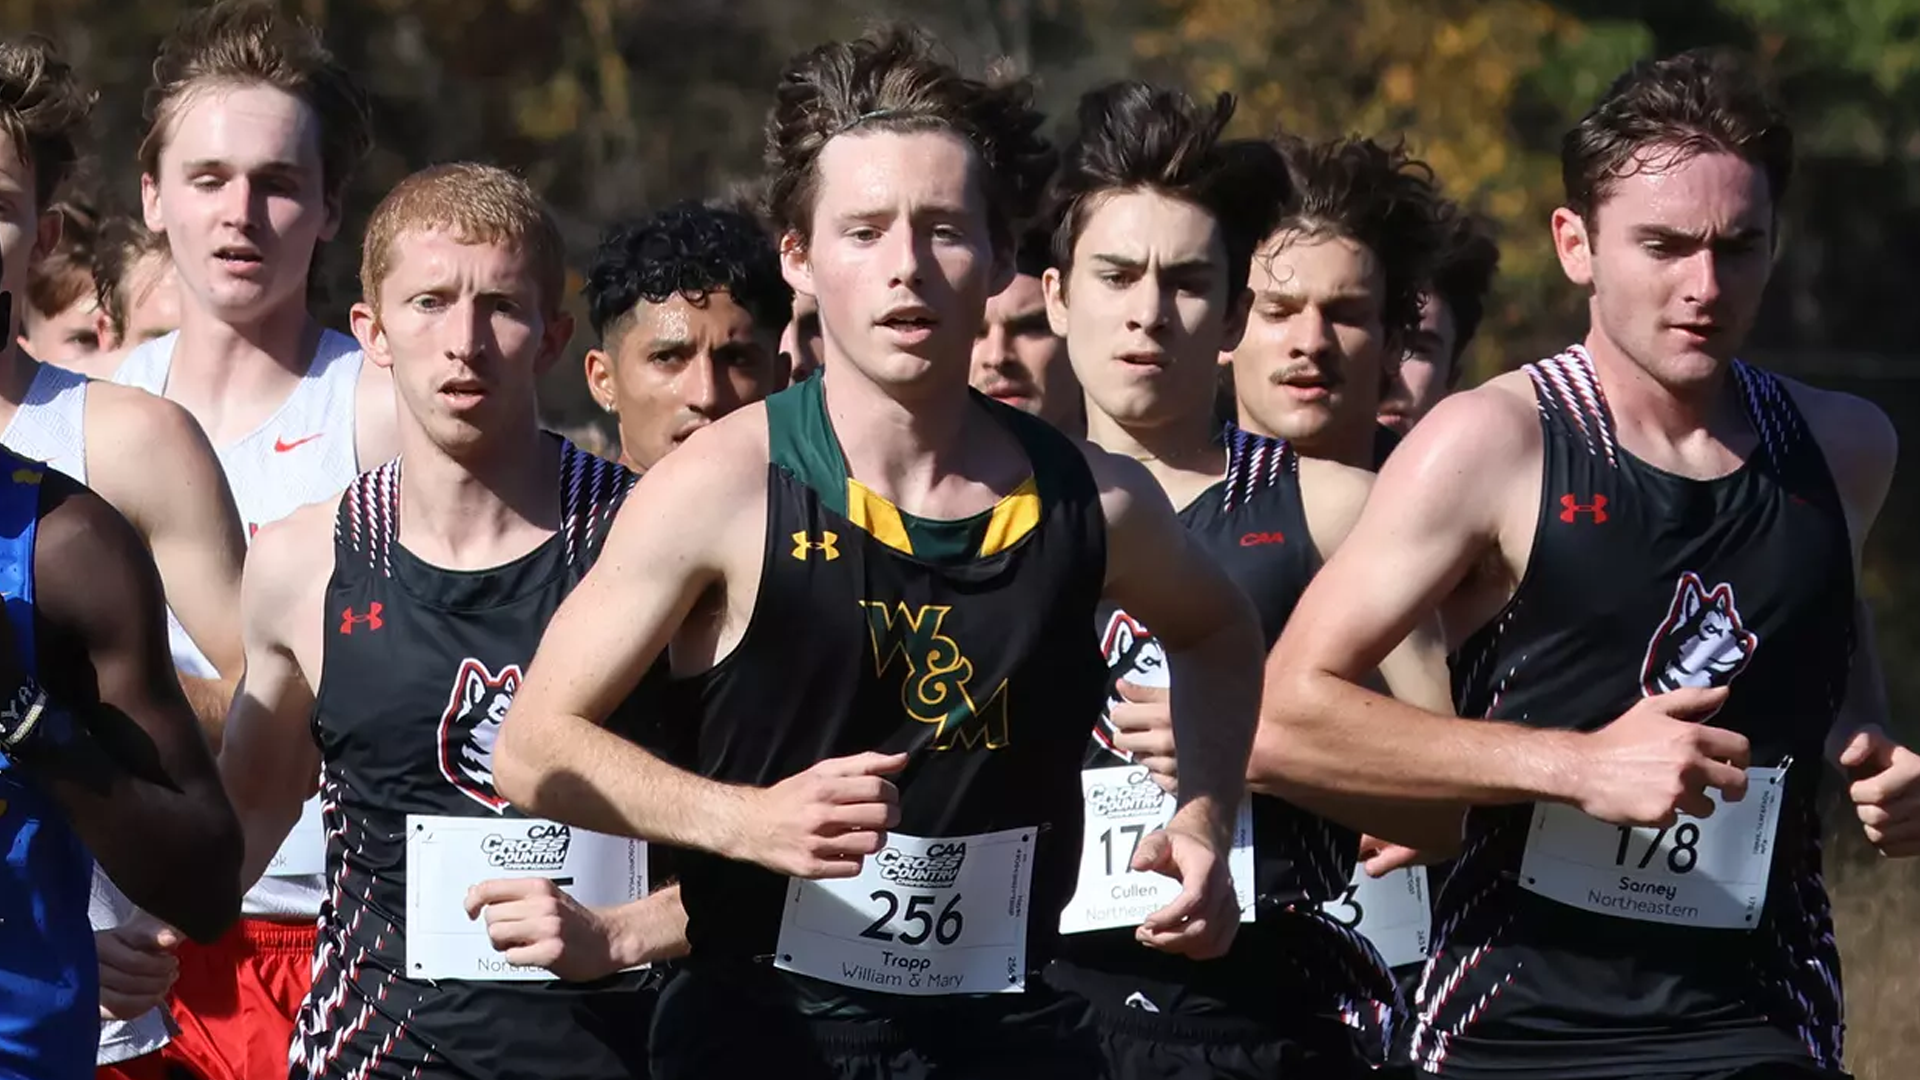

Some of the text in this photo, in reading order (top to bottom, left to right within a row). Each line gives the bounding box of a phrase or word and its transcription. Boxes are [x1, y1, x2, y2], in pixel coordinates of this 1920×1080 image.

[1239, 531, 1285, 547] CAA
[528, 825, 571, 839] CAA
[482, 834, 569, 856] CROSS
[927, 842, 966, 857] CAA
[1100, 822, 1163, 876] 17
[1615, 822, 1700, 873] 178
[488, 850, 566, 867] COUNTRY
[876, 848, 963, 870] CROSS
[881, 865, 959, 882] COUNTRY
[1111, 883, 1158, 900] Cullen
[1619, 876, 1677, 900] Sarney
[1588, 889, 1699, 919] Northeastern
[859, 889, 965, 946] 256
[882, 951, 931, 970] Trapp
[842, 961, 965, 988] William & Mary
